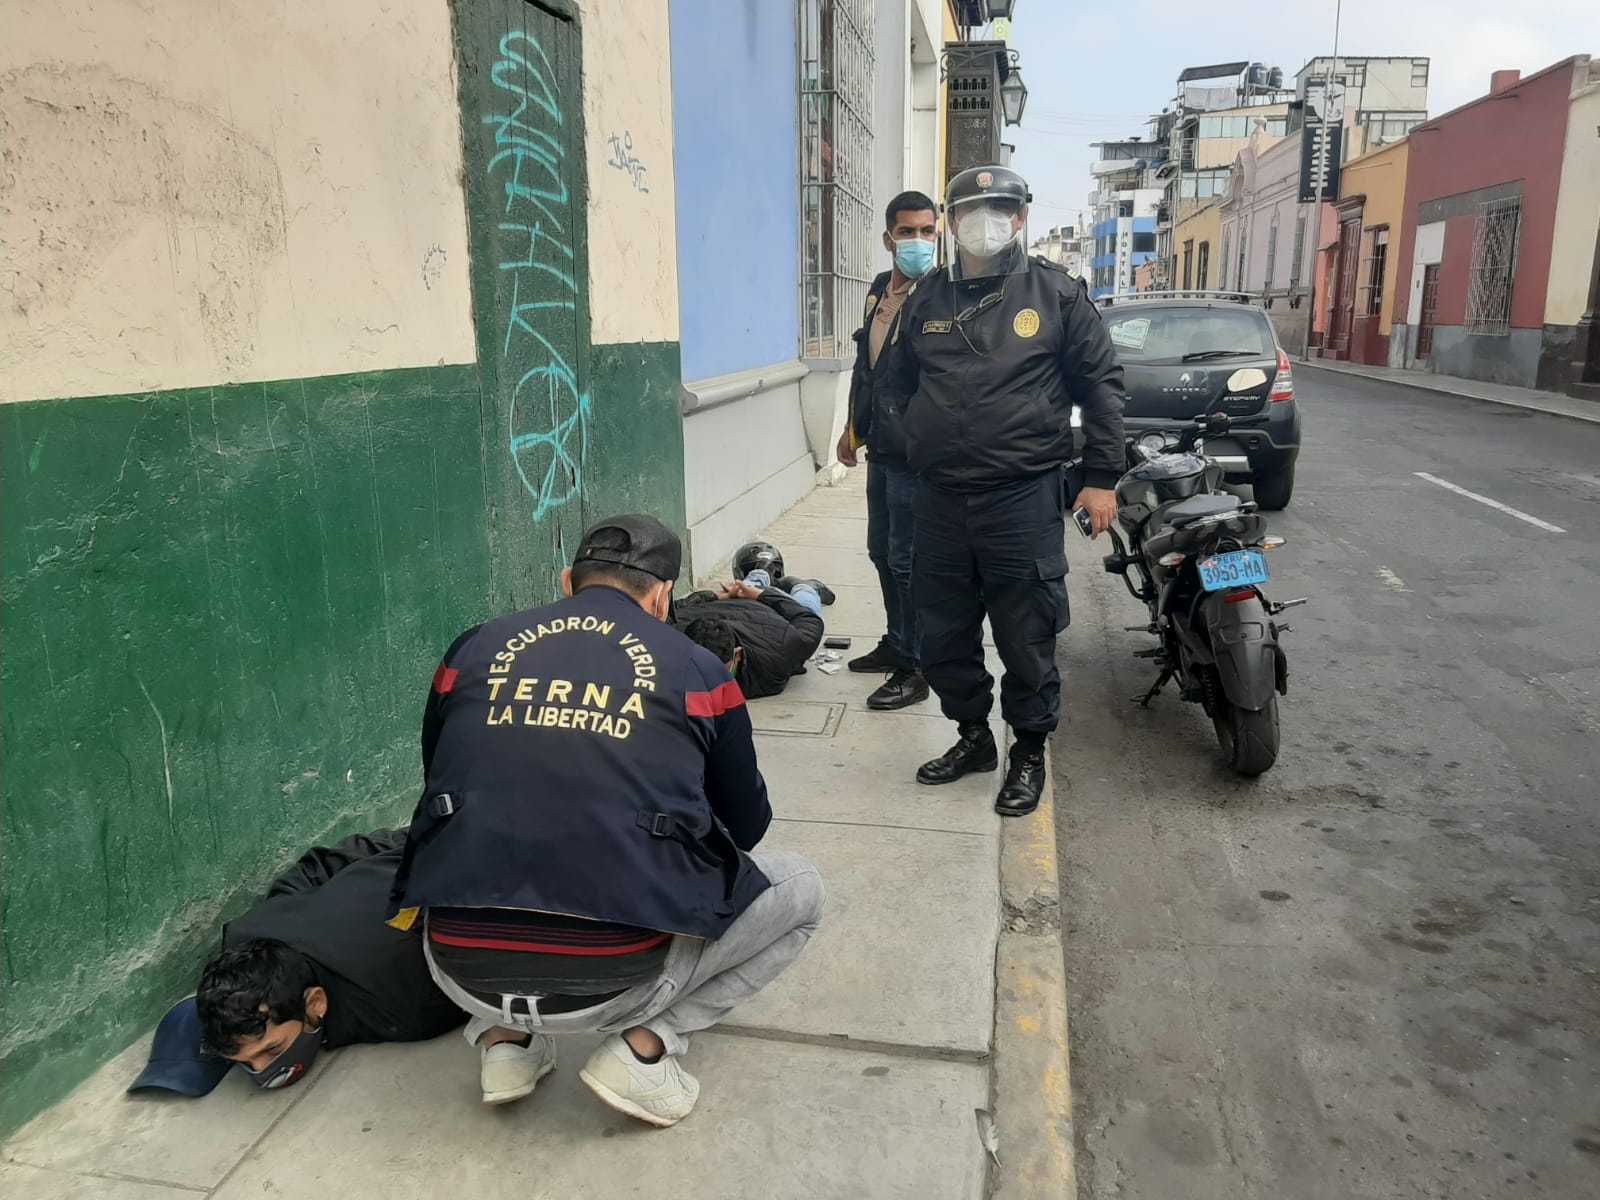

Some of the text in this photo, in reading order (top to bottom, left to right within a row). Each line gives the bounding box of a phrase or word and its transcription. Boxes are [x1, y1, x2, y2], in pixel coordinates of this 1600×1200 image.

[1120, 231, 1128, 286] HOSTAL
[1217, 555, 1242, 565] PERU
[489, 615, 657, 693] ESCUADRON VERDE
[487, 678, 645, 719] TERNA
[487, 705, 631, 739] LA LIBERTAD
